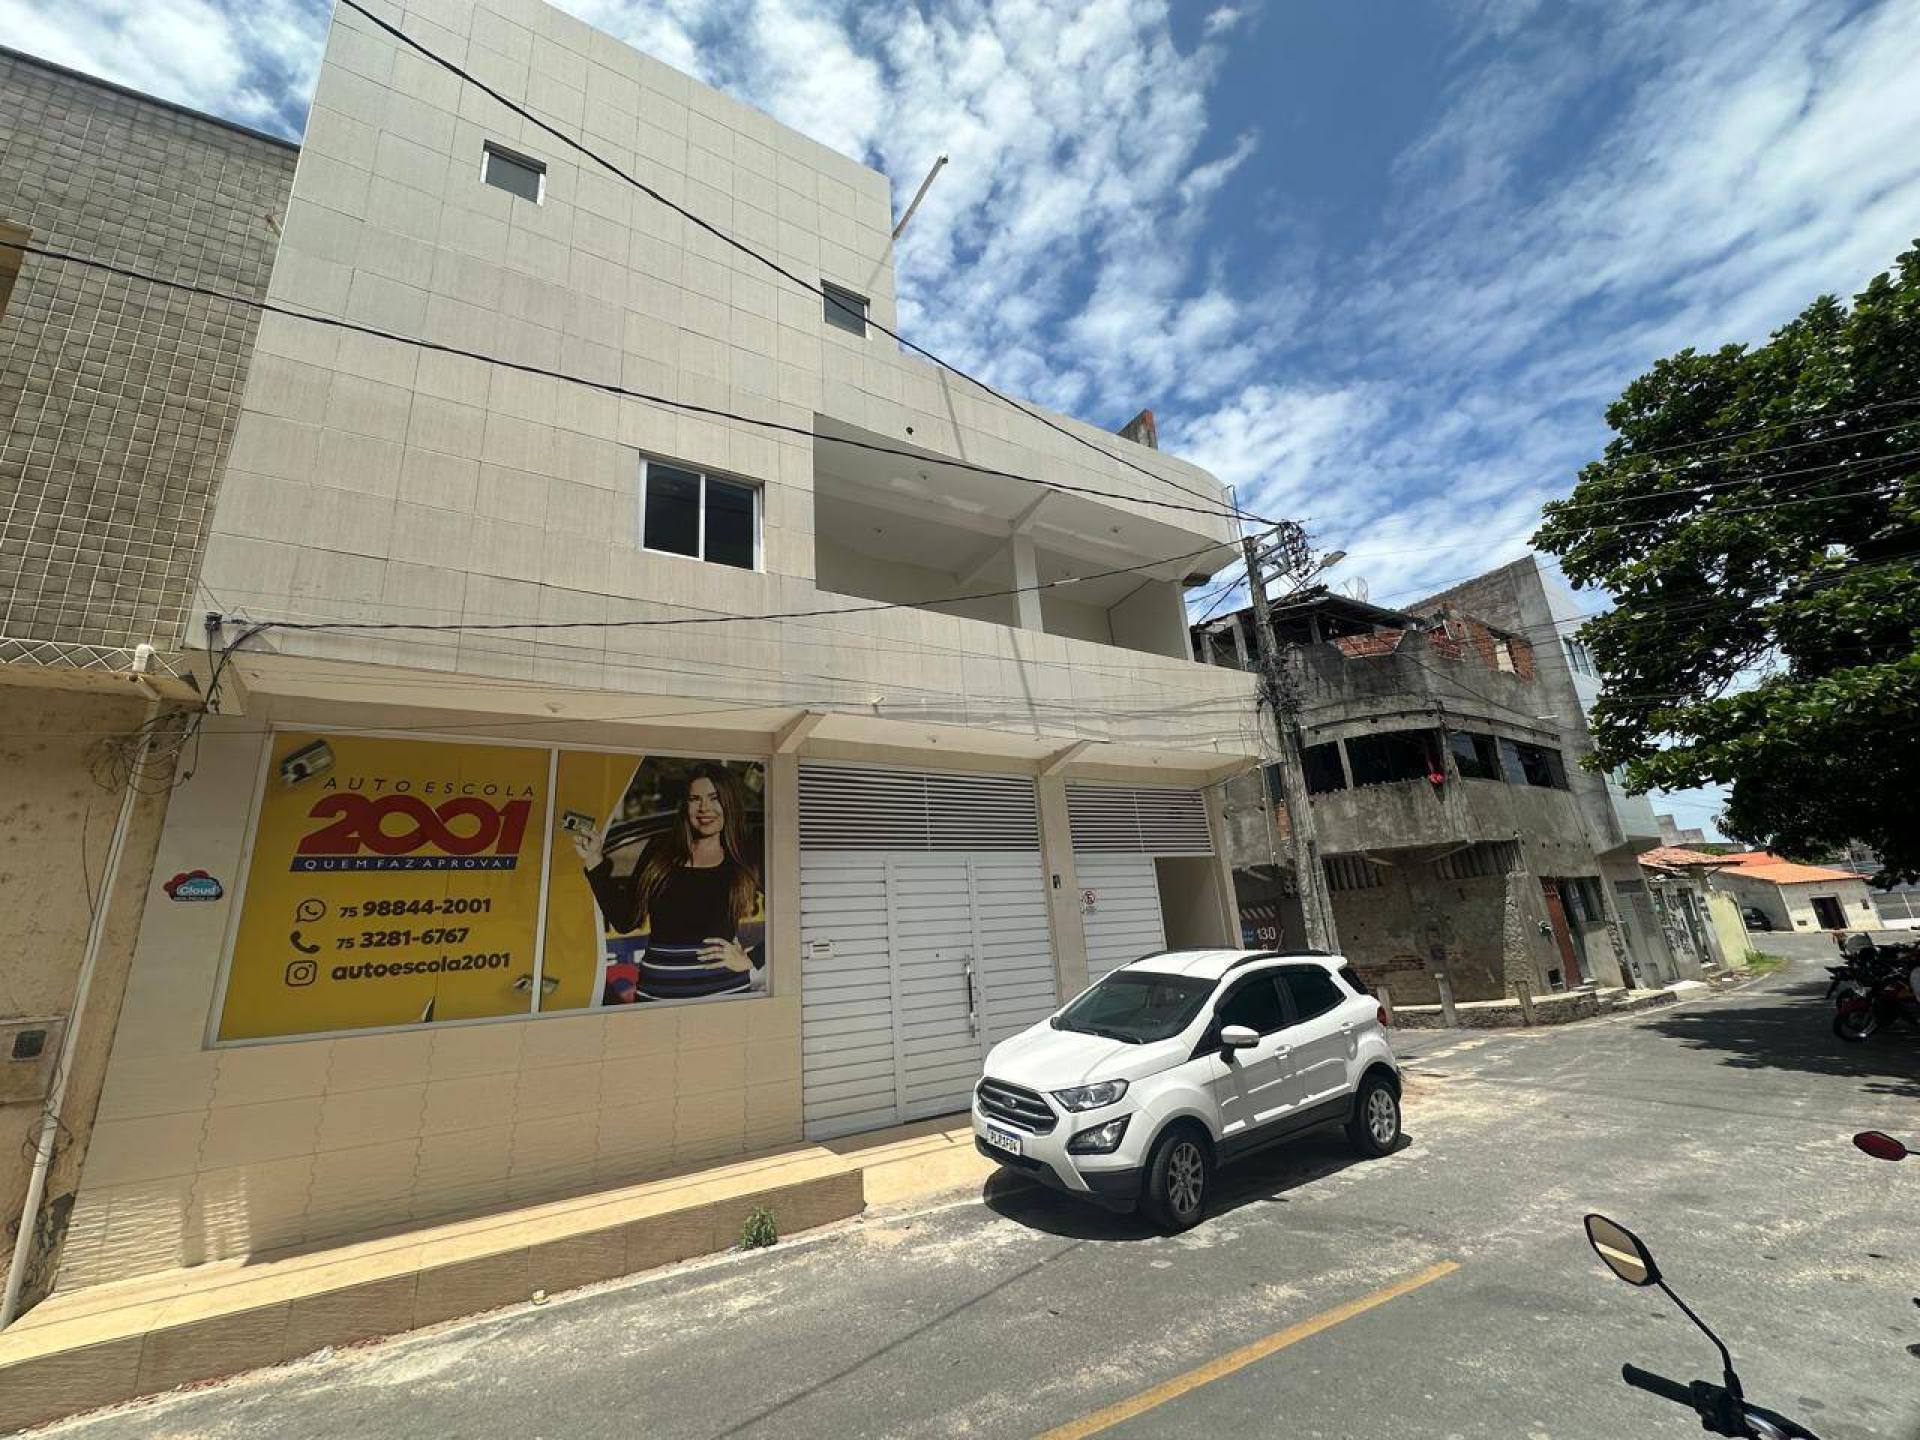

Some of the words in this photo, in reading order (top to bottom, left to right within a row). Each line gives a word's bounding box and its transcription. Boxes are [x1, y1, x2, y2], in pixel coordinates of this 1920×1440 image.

[324, 777, 410, 793] AUTO
[424, 781, 534, 797] ESCOLA
[296, 792, 532, 856] 2001
[304, 858, 368, 871] QUEM
[376, 858, 414, 869] FAZ
[422, 857, 512, 869] APROVA!
[338, 906, 358, 918] 75
[362, 898, 492, 917] 98844-2001
[336, 938, 355, 949] 75
[359, 927, 471, 948] 3281-6767
[331, 952, 512, 981] autoescola2001
